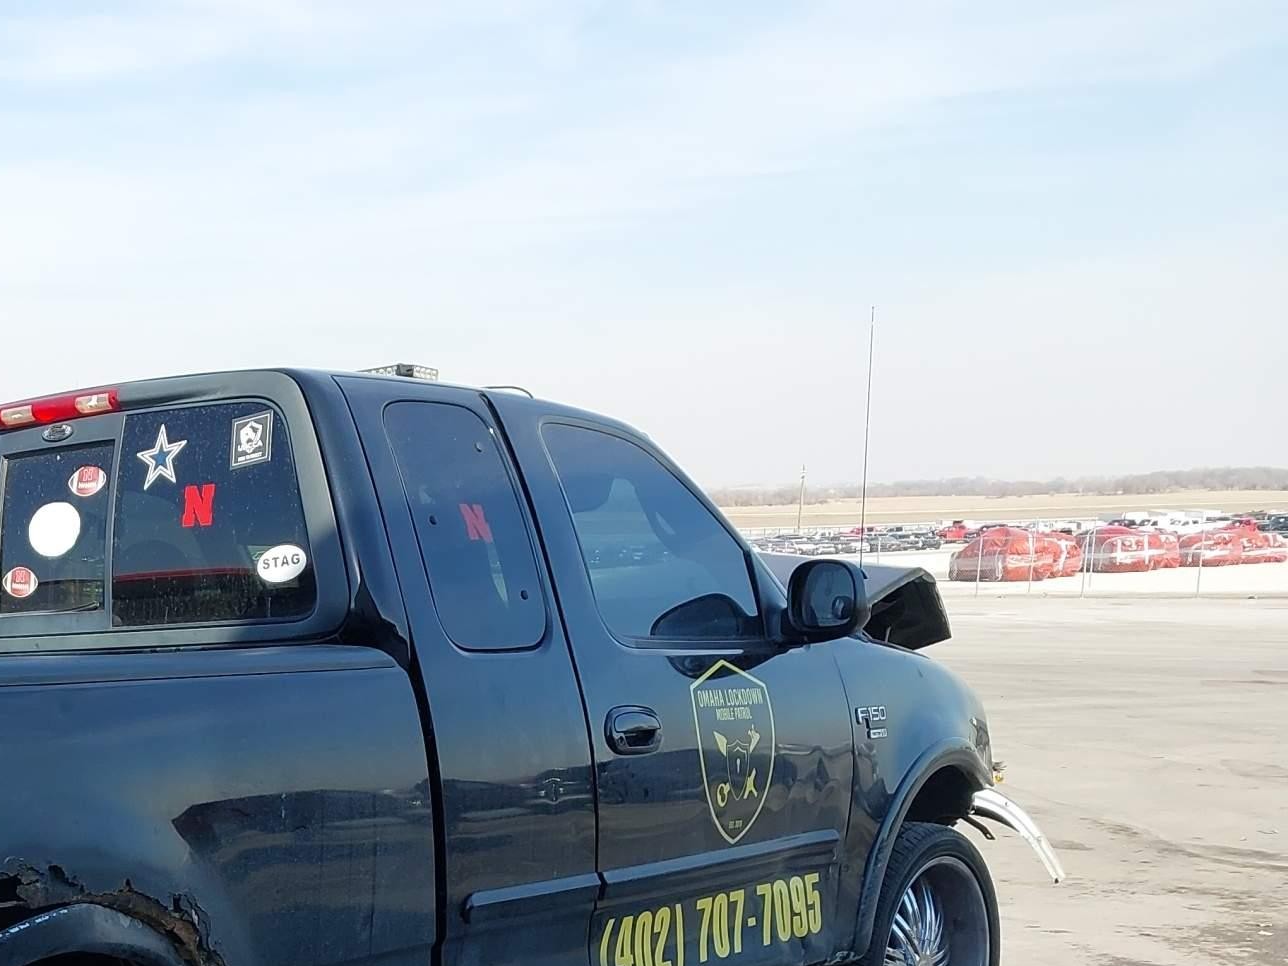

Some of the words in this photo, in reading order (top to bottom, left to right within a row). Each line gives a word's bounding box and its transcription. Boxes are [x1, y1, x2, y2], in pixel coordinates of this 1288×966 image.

[182, 484, 216, 527] N
[458, 503, 493, 543] N
[262, 553, 301, 570] STAG
[697, 689, 725, 707] OMAHA
[724, 688, 764, 706] LOCKDOWN
[715, 708, 735, 721] MOBILE
[734, 706, 753, 720] PATROL
[695, 872, 823, 963] 707-7095
